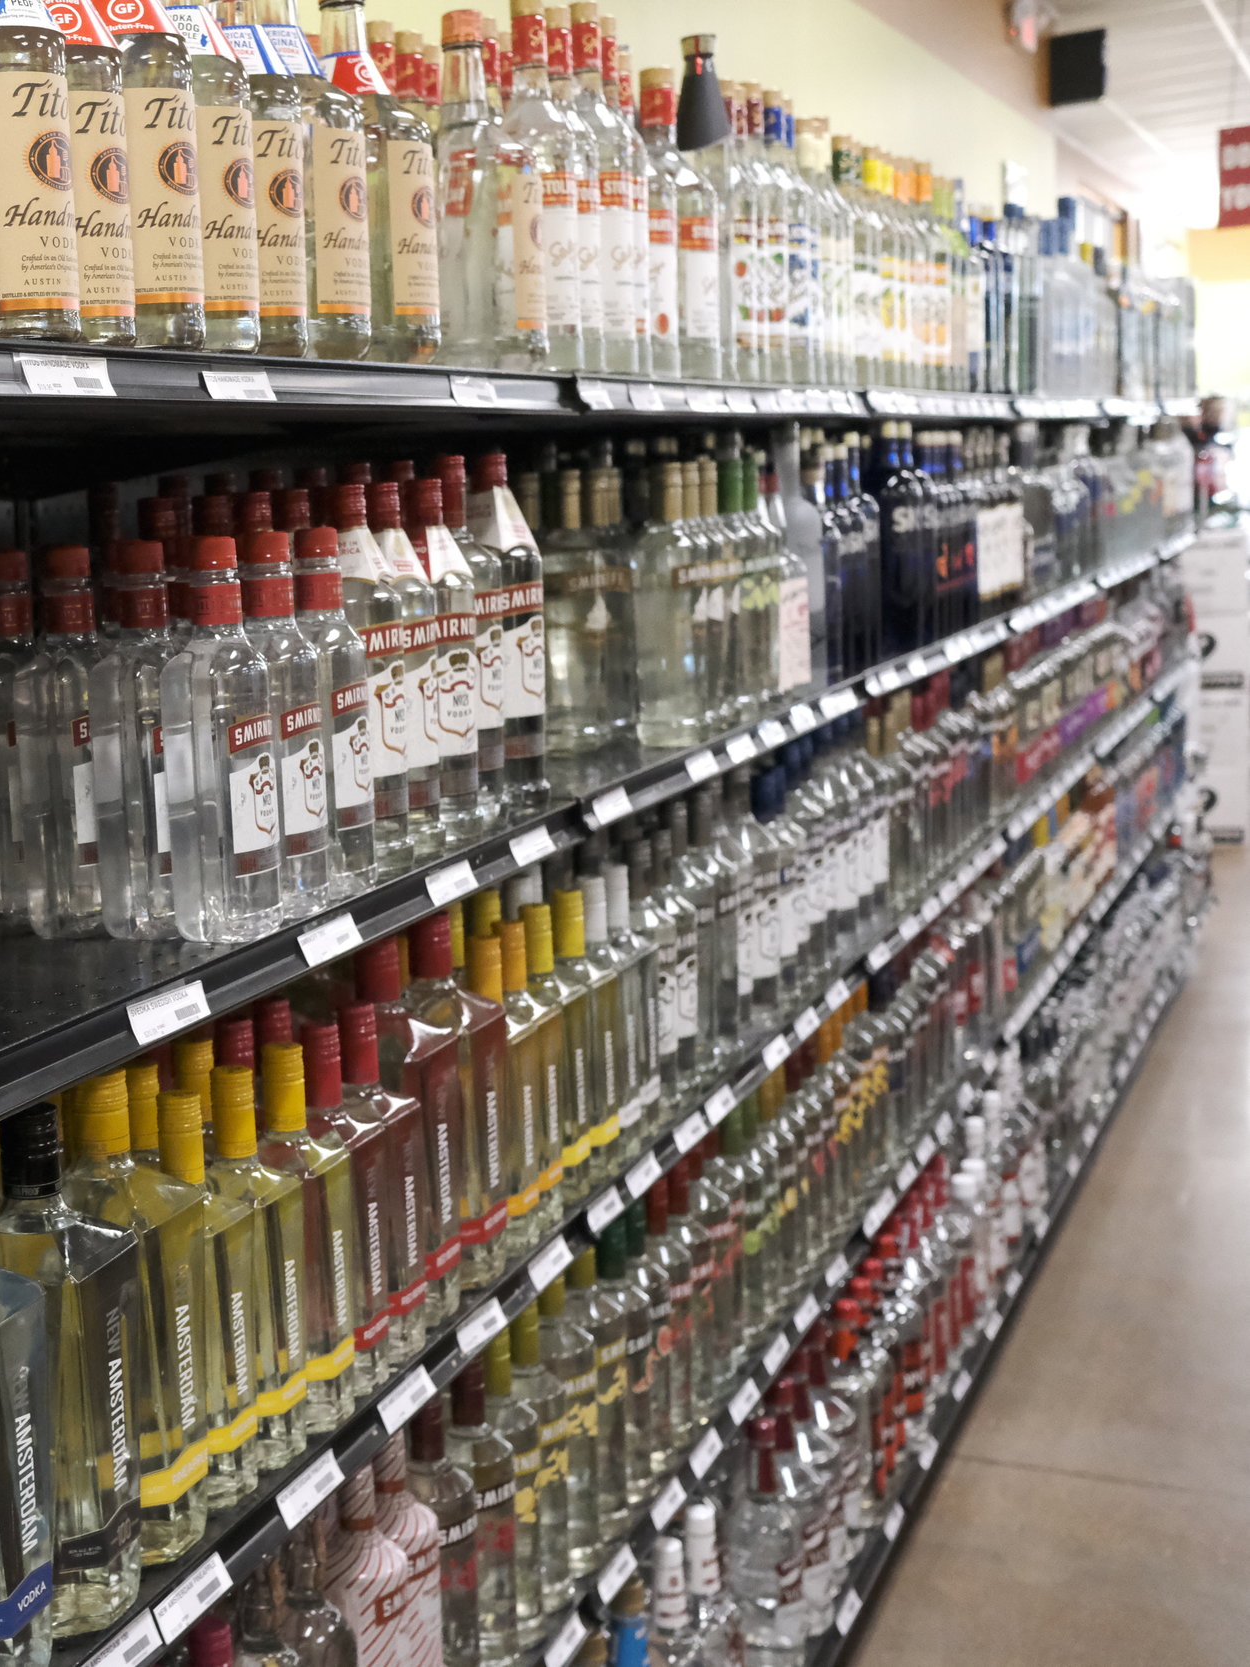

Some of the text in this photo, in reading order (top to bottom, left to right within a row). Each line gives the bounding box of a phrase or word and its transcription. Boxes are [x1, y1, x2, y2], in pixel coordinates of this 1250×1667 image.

[114, 2, 136, 15] GF
[404, 1175, 418, 1268] AMSTERDAM
[437, 1122, 452, 1225] AMSTERDAM
[332, 1229, 348, 1327] AMSTERDAM
[367, 1201, 383, 1297] AMSTERDAM
[231, 1290, 249, 1396] AMSTERDAM
[284, 1258, 299, 1360] AMSTERDAM
[175, 1304, 197, 1431] AMSTERDAM
[108, 1357, 128, 1493] AMSTERDAM
[14, 1412, 39, 1556] AMSTERDAM
[17, 1580, 47, 1612] VODKA
